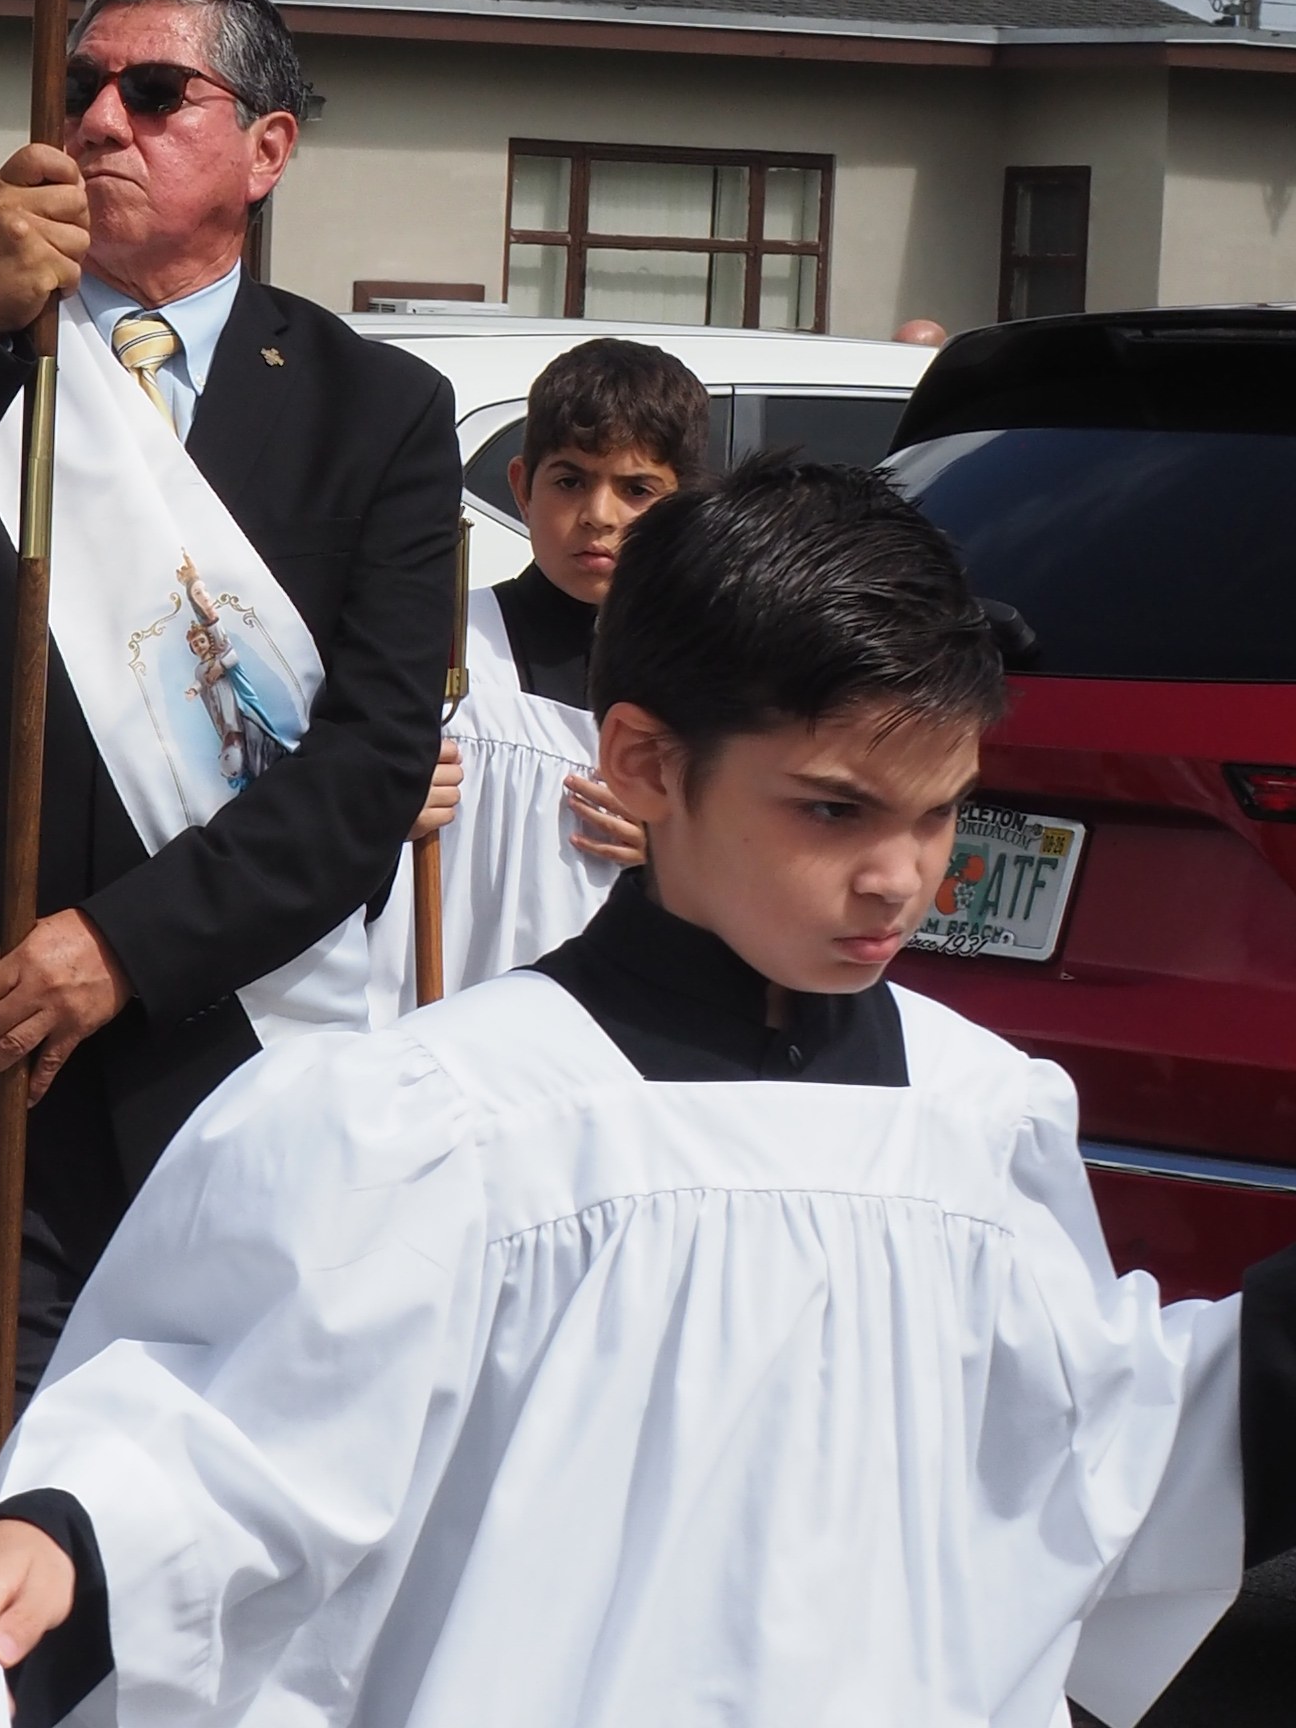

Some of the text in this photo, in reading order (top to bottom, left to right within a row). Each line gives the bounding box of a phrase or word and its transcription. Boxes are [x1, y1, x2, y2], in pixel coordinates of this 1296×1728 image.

[959, 803, 1027, 832] PLETON
[978, 853, 1059, 920] ATF
[908, 934, 989, 955] ince 1931
